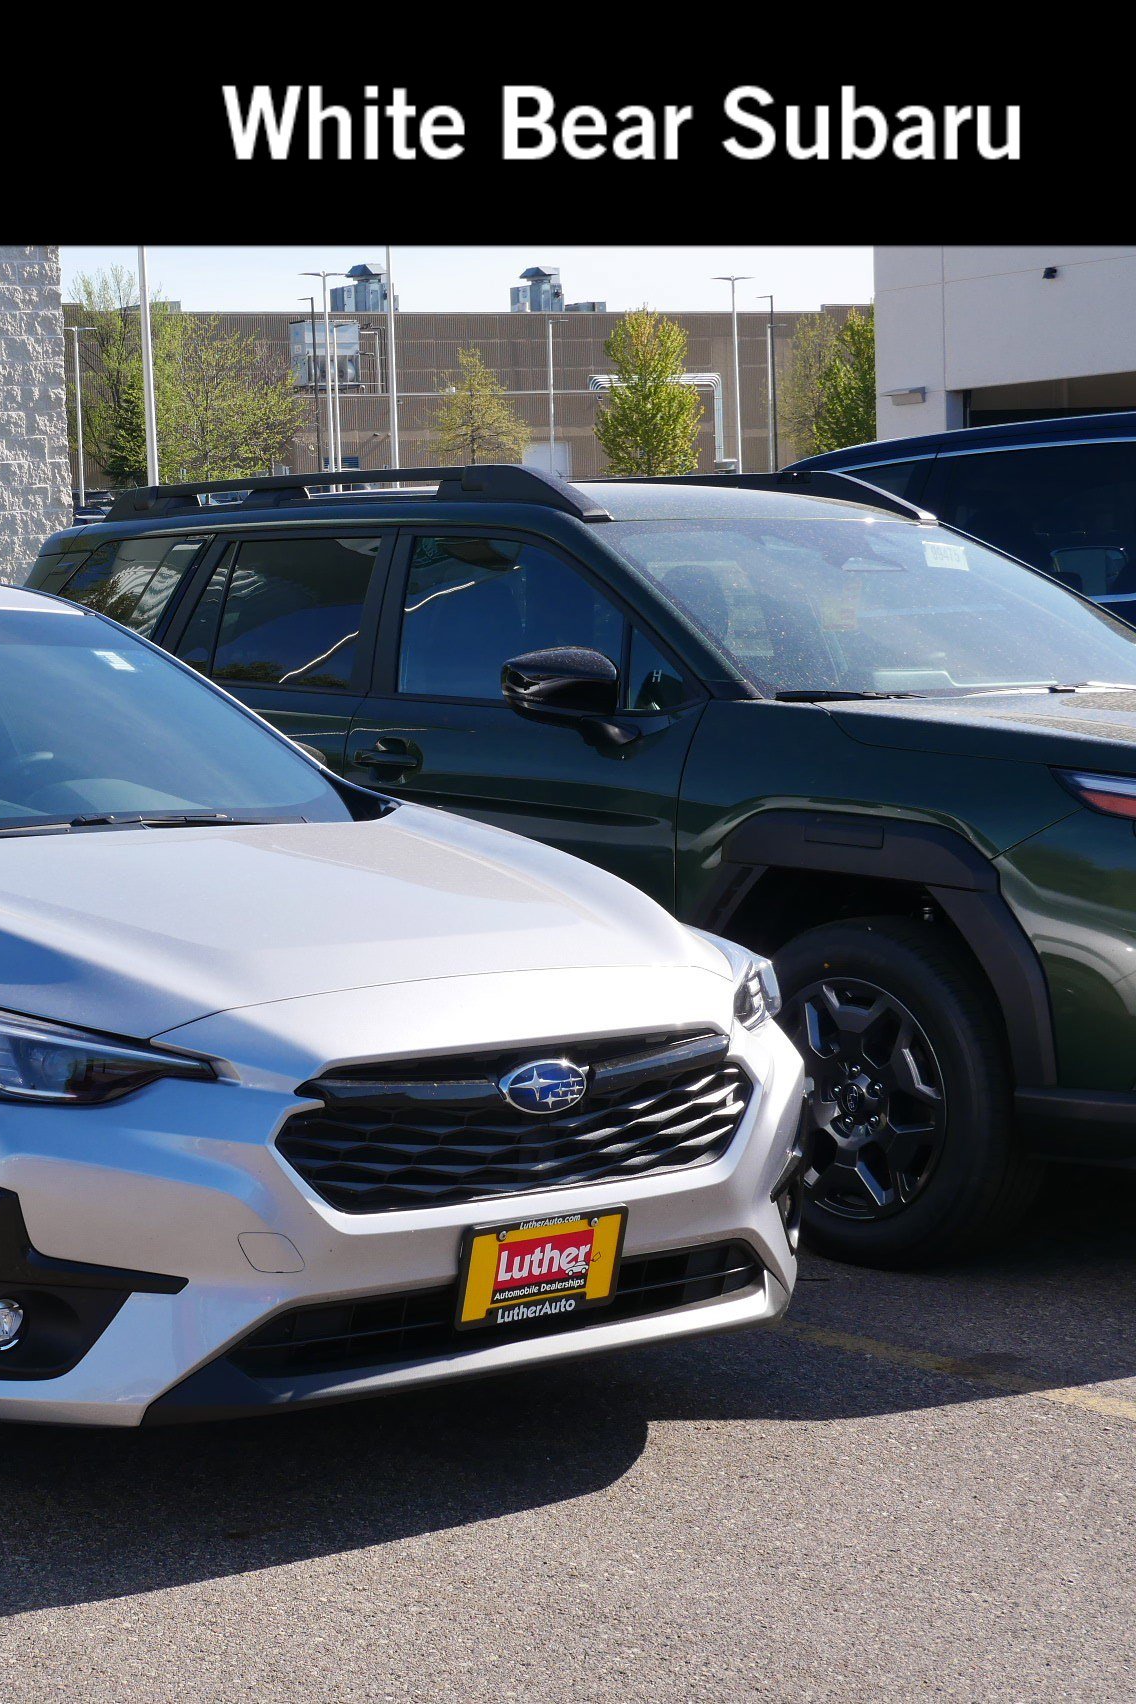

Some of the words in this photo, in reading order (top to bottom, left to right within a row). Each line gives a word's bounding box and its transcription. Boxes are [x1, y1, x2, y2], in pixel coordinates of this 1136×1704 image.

[519, 1214, 581, 1230] LutherAuto.com
[497, 1243, 591, 1282] Luther
[493, 1285, 539, 1300] Automobile
[540, 1278, 585, 1292] Dealerships
[496, 1298, 576, 1323] LutherAuto
